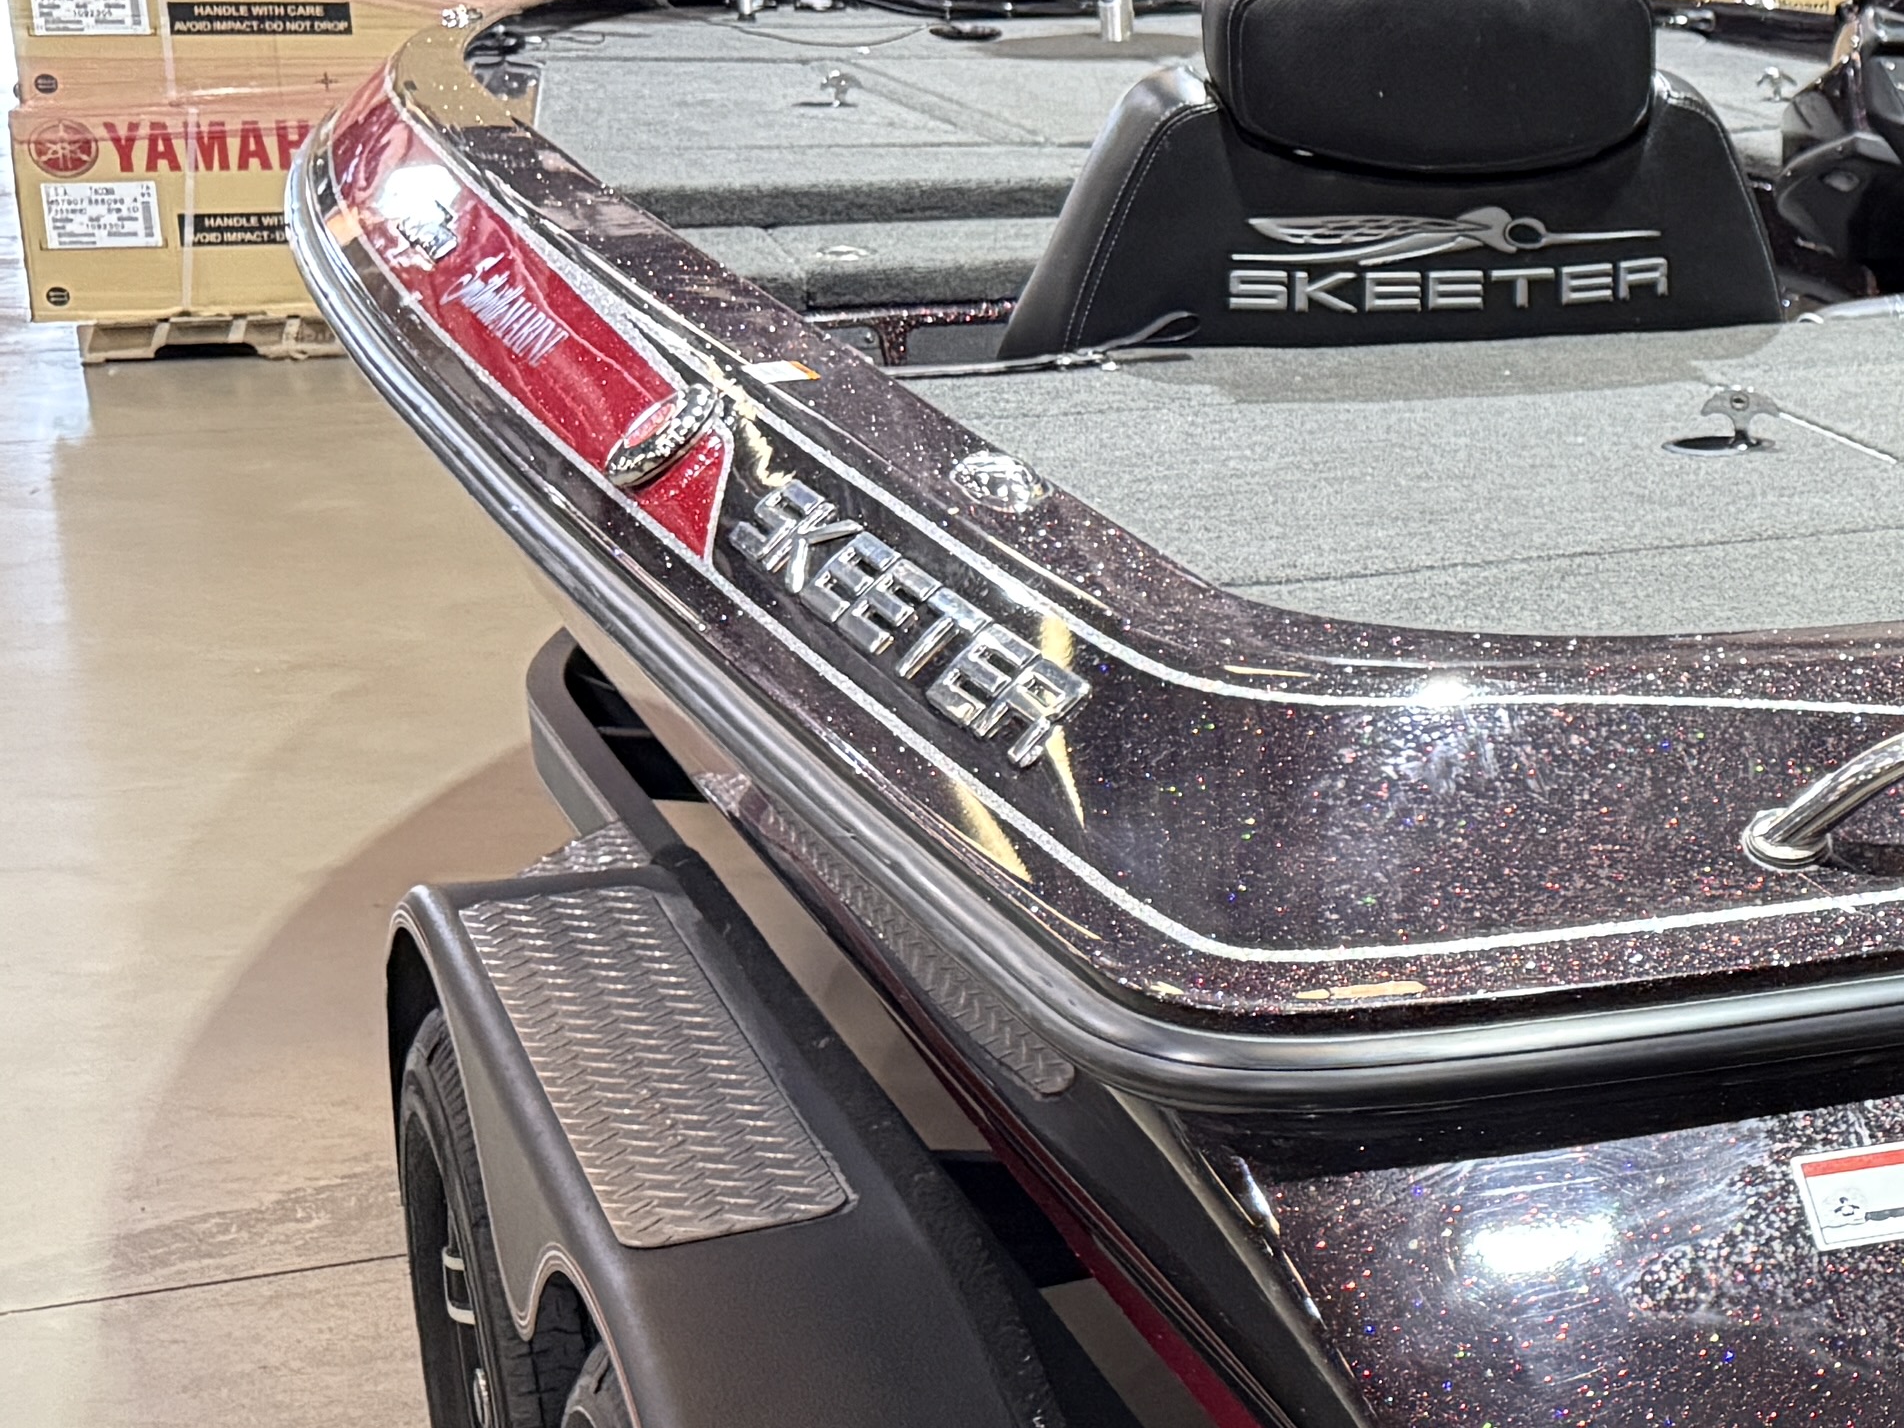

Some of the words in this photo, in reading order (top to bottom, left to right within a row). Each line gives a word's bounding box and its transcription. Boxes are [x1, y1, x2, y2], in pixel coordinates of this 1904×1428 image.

[194, 5, 249, 17] HANDLE
[252, 5, 285, 16] WITH
[287, 5, 324, 16] CARE
[174, 20, 211, 32] AVOID
[213, 21, 259, 31] IMPACT
[265, 20, 284, 31] DO
[286, 20, 311, 31] NOT
[314, 20, 348, 31] DROP
[102, 119, 309, 173] YAMAH
[205, 215, 259, 228] HANDLE
[261, 215, 285, 227] WIT
[223, 231, 269, 242] IMPACT
[1228, 258, 1669, 315] SKEETER
[729, 478, 1092, 769] SKEETER
